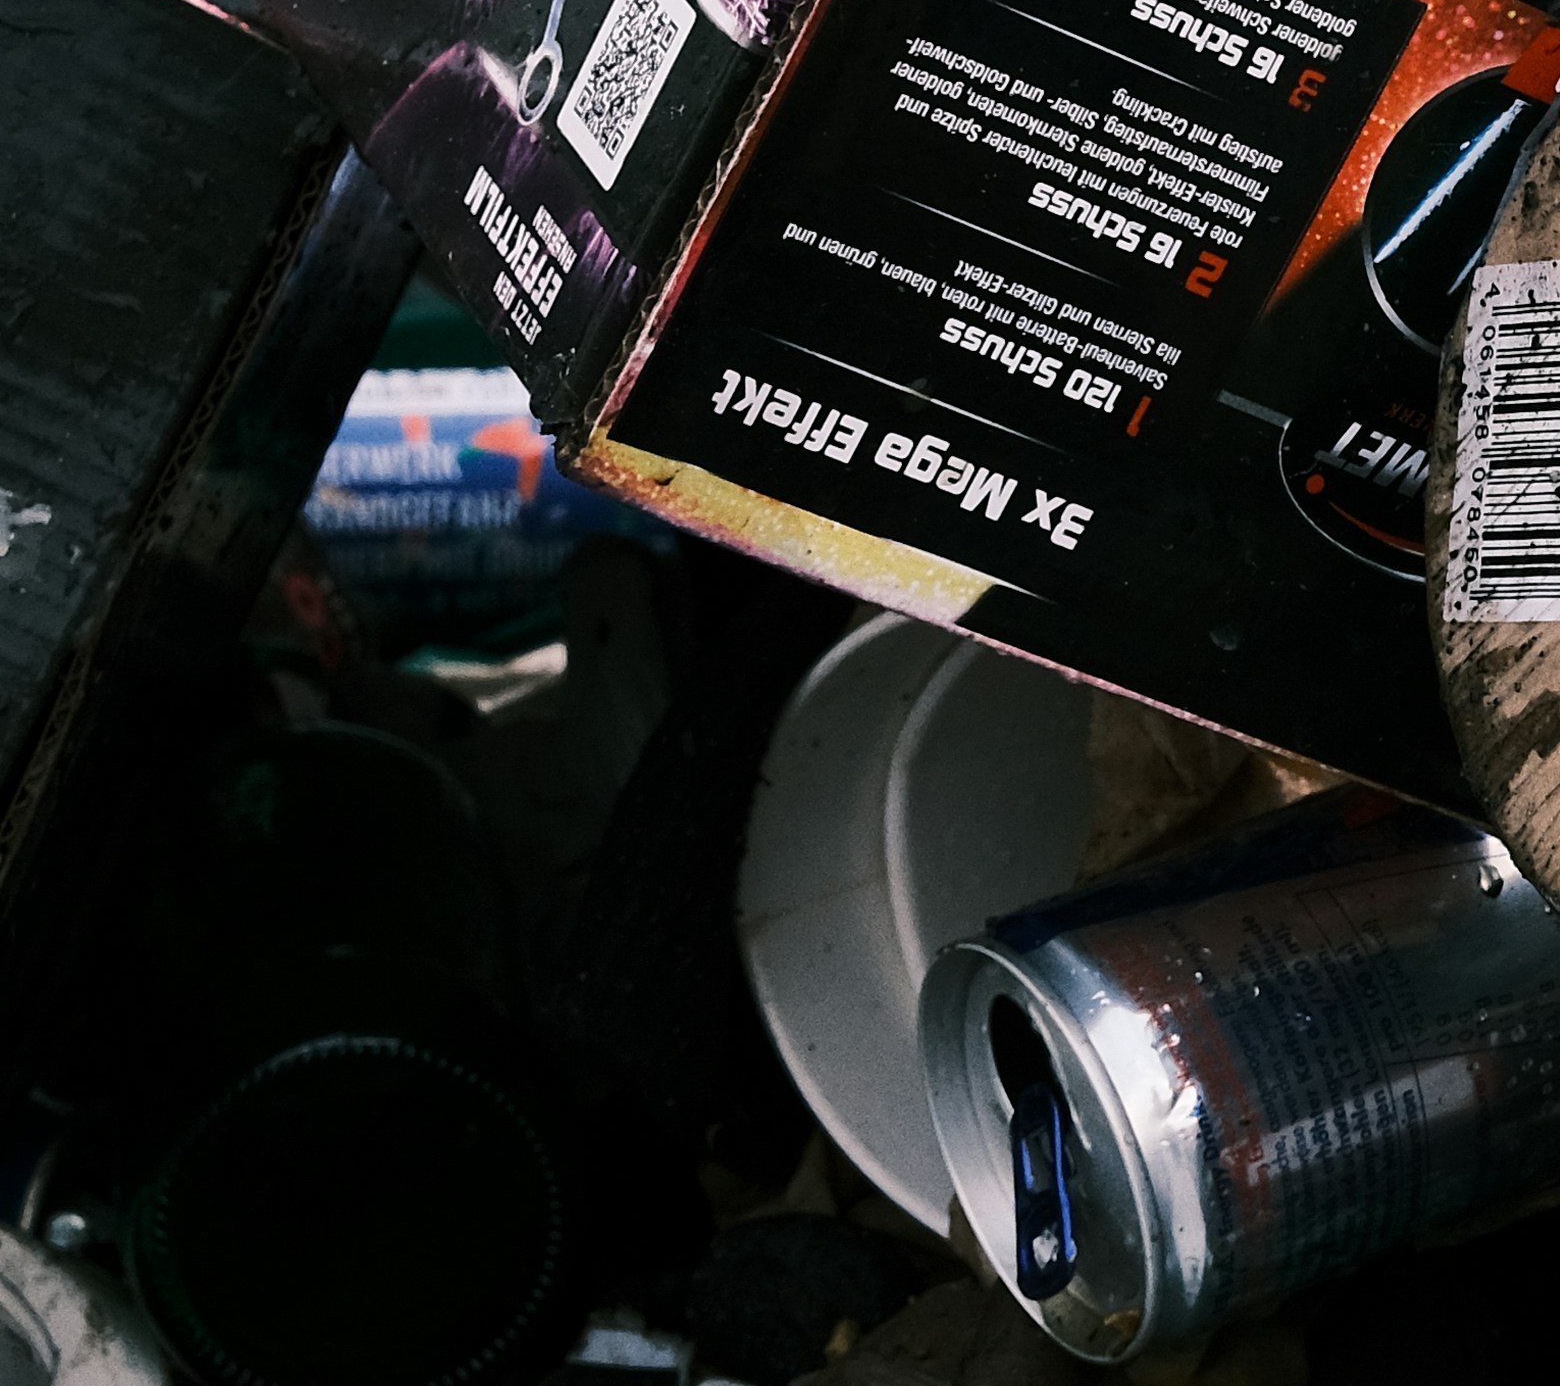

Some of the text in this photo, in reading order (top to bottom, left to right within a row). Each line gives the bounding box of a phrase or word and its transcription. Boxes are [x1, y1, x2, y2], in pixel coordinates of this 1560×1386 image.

[1246, 46, 1284, 83] 16
[894, 93, 1243, 248] rote Feuerzungen mit leuchtender Spitze und
[464, 167, 561, 322] EFFEKTFILM
[532, 206, 576, 272] ANSEHEN
[1028, 182, 1227, 297] 2 16 Schuss
[493, 271, 541, 344] JETZT DEN
[782, 222, 1167, 389] Salvenheul-Batterie mit roten, blauen, grünen und
[940, 318, 1062, 387] Schuss
[954, 260, 1181, 365] lila Sternen und Glitzer-Effekt
[1063, 369, 1121, 412] 120
[1466, 325, 1504, 440] 061458
[713, 370, 1092, 549] 3x Mega Effekt
[1454, 465, 1493, 585] 078450
